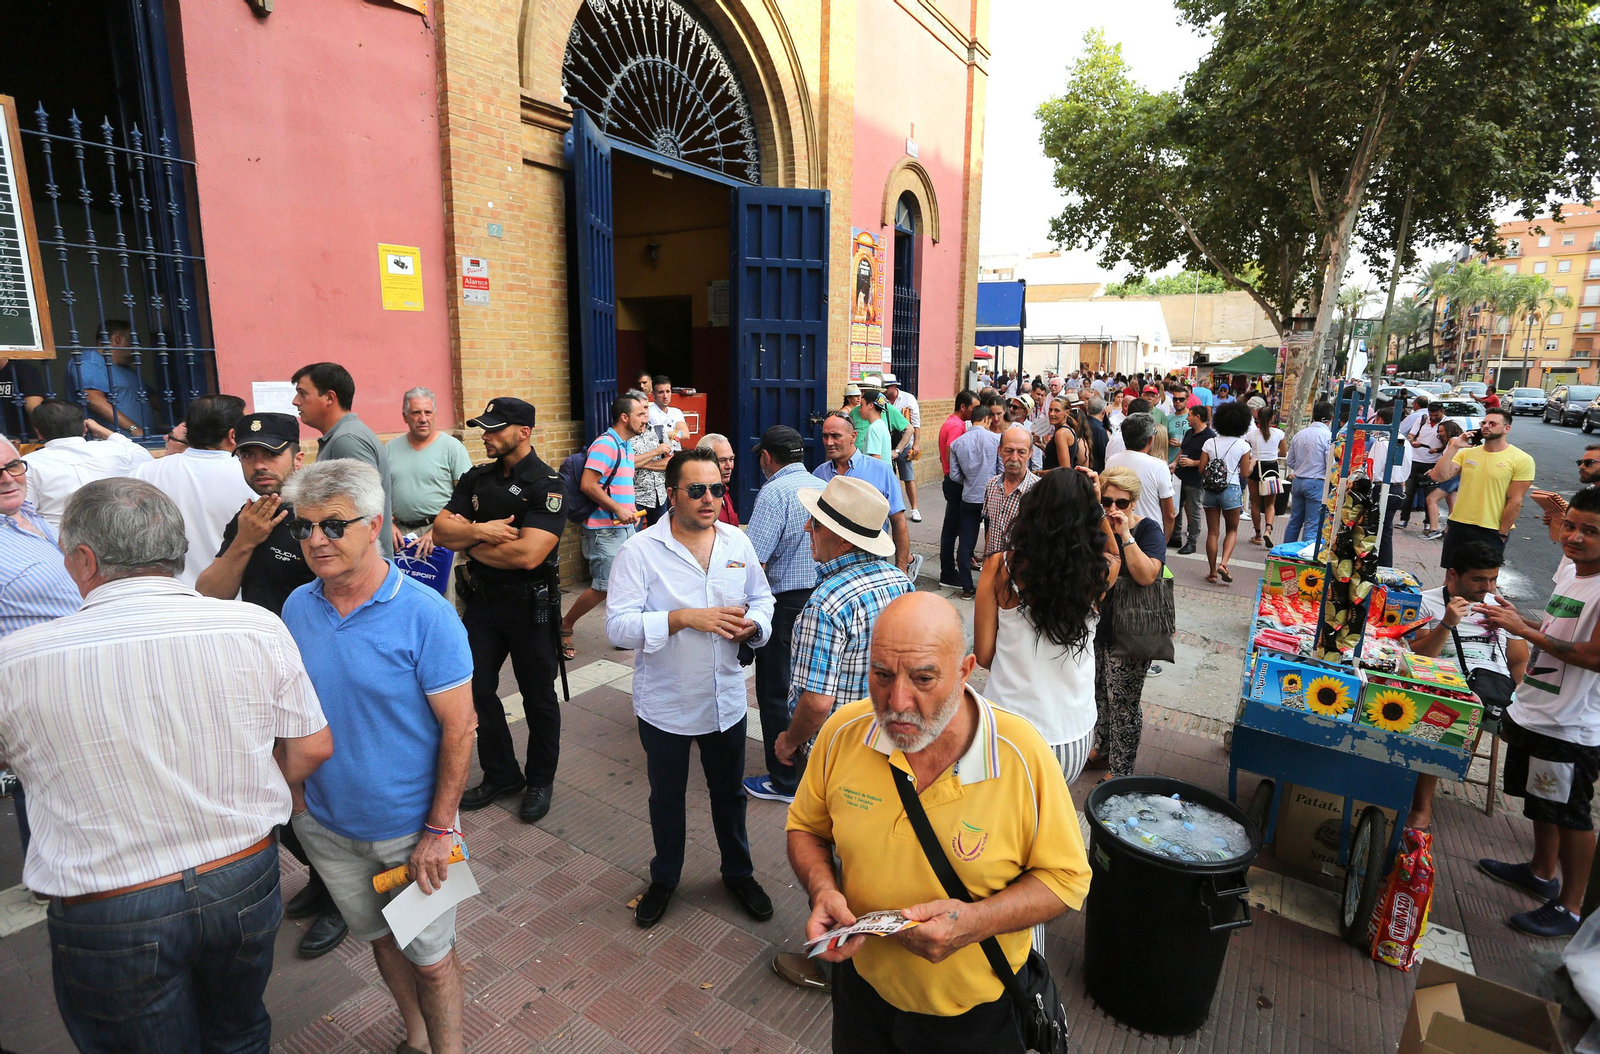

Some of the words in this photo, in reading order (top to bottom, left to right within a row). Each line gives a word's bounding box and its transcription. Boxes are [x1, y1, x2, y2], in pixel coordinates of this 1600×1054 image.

[492, 225, 498, 236] 2
[464, 278, 488, 286] Alarma
[411, 571, 437, 580] SPORT
